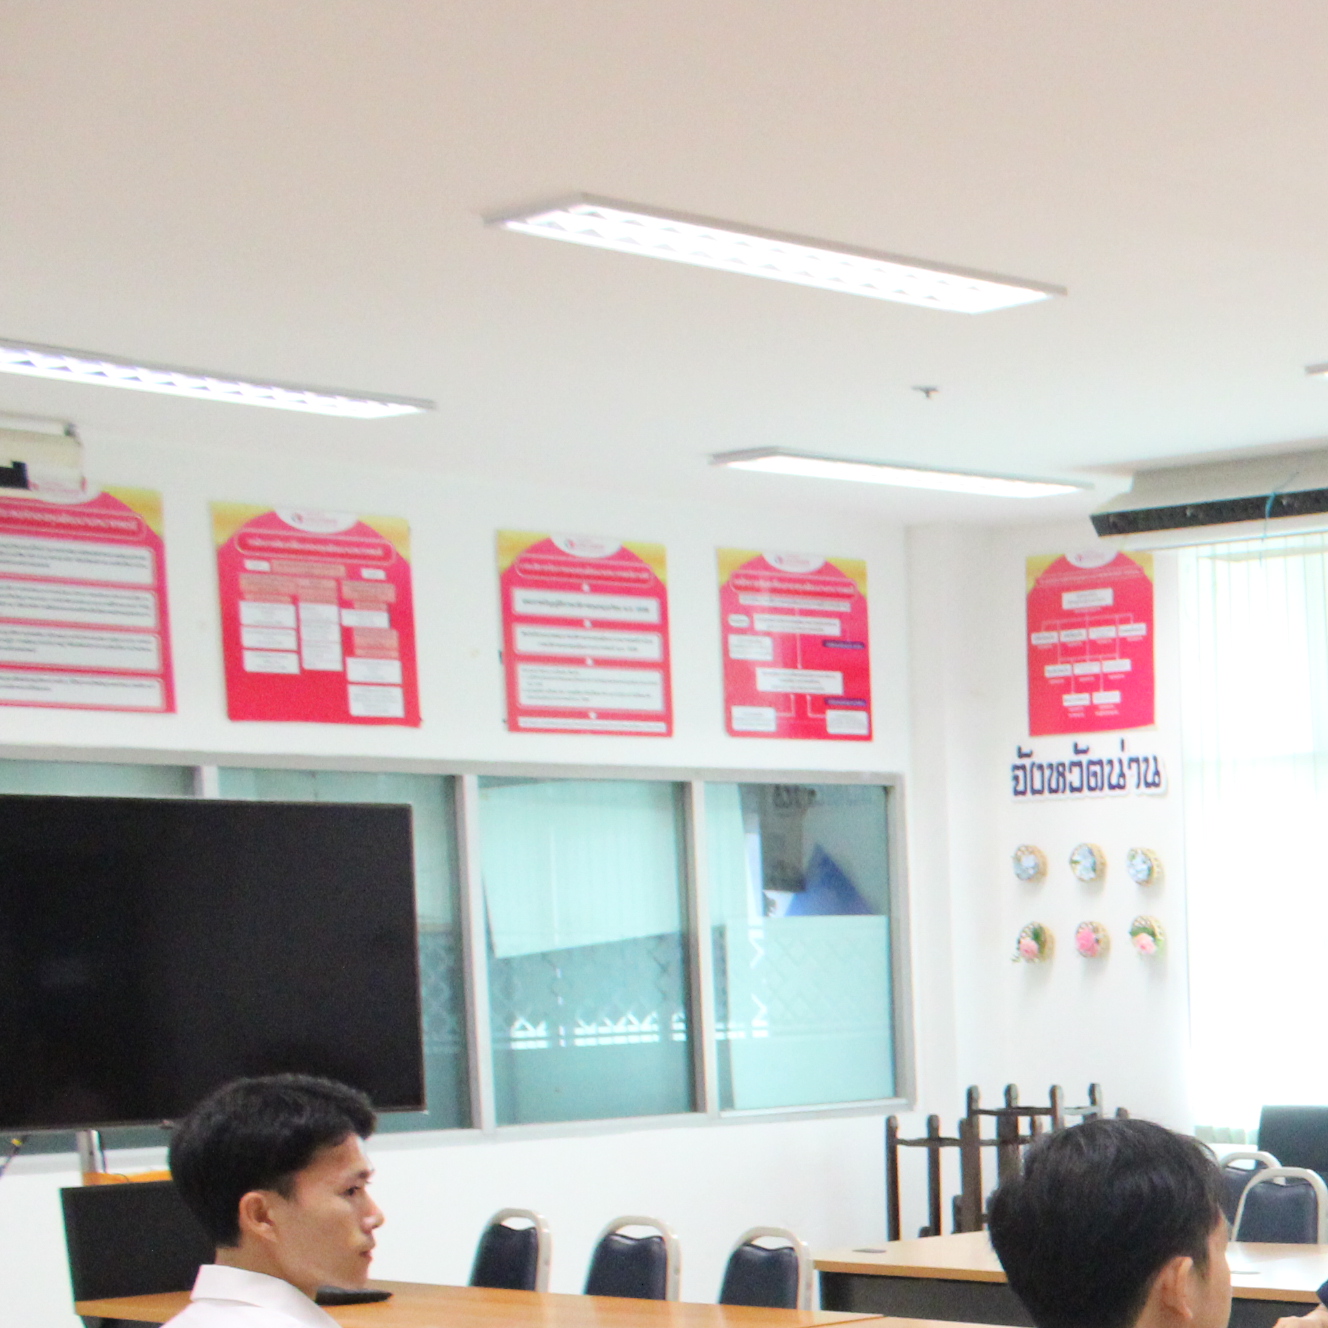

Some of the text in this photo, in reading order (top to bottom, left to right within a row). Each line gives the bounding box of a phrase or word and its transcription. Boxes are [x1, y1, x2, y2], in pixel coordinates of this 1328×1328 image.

[1011, 737, 1161, 796] จังหวัดน่าน
